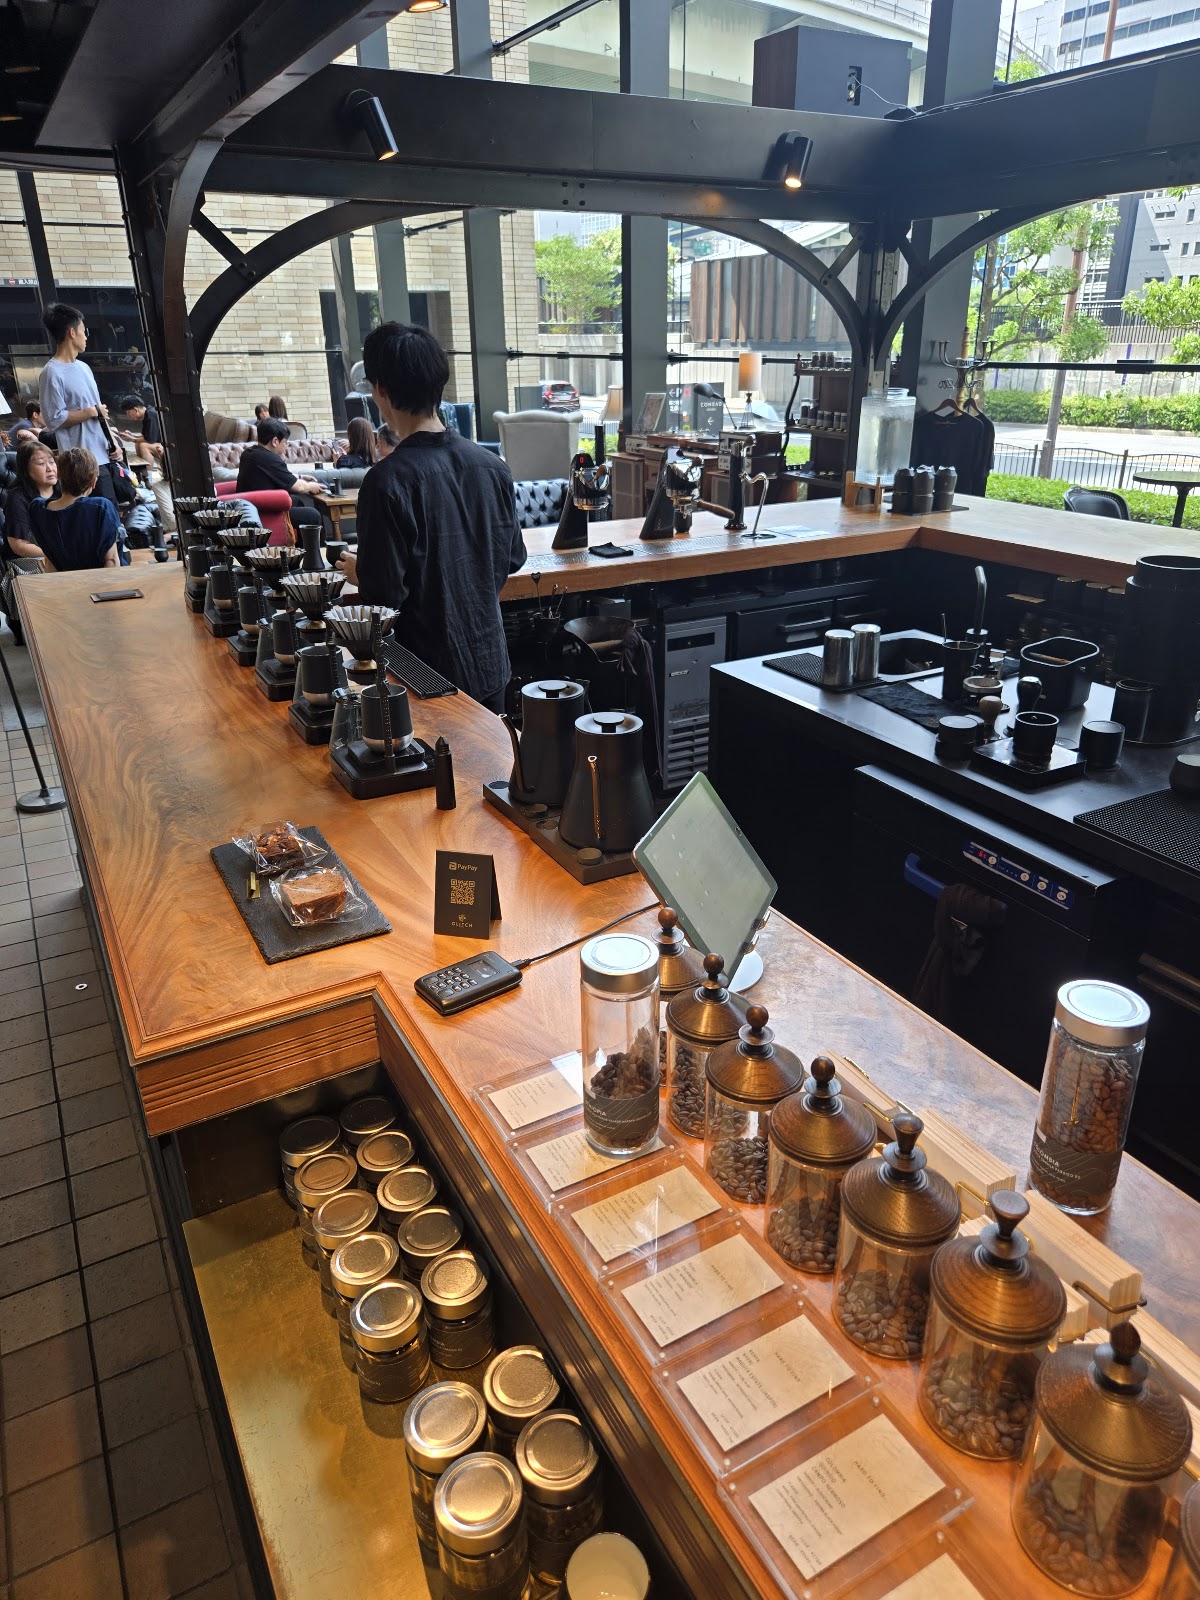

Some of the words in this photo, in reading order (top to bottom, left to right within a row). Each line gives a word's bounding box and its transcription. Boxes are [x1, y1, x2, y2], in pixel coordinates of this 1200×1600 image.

[457, 864, 478, 872] PayPay
[748, 1349, 760, 1362] KENYA
[774, 1351, 785, 1364] HARD
[789, 1371, 801, 1382] FIND
[748, 1373, 762, 1388] ESTATE
[817, 1461, 837, 1483] QUINDIO
[824, 1457, 847, 1483] COLOMBIA
[853, 1460, 867, 1475] HARD
[866, 1475, 874, 1484] TO
[872, 1483, 886, 1498] FIND
[811, 1466, 826, 1483] CAMPO
[824, 1483, 846, 1508] HERMOSO
